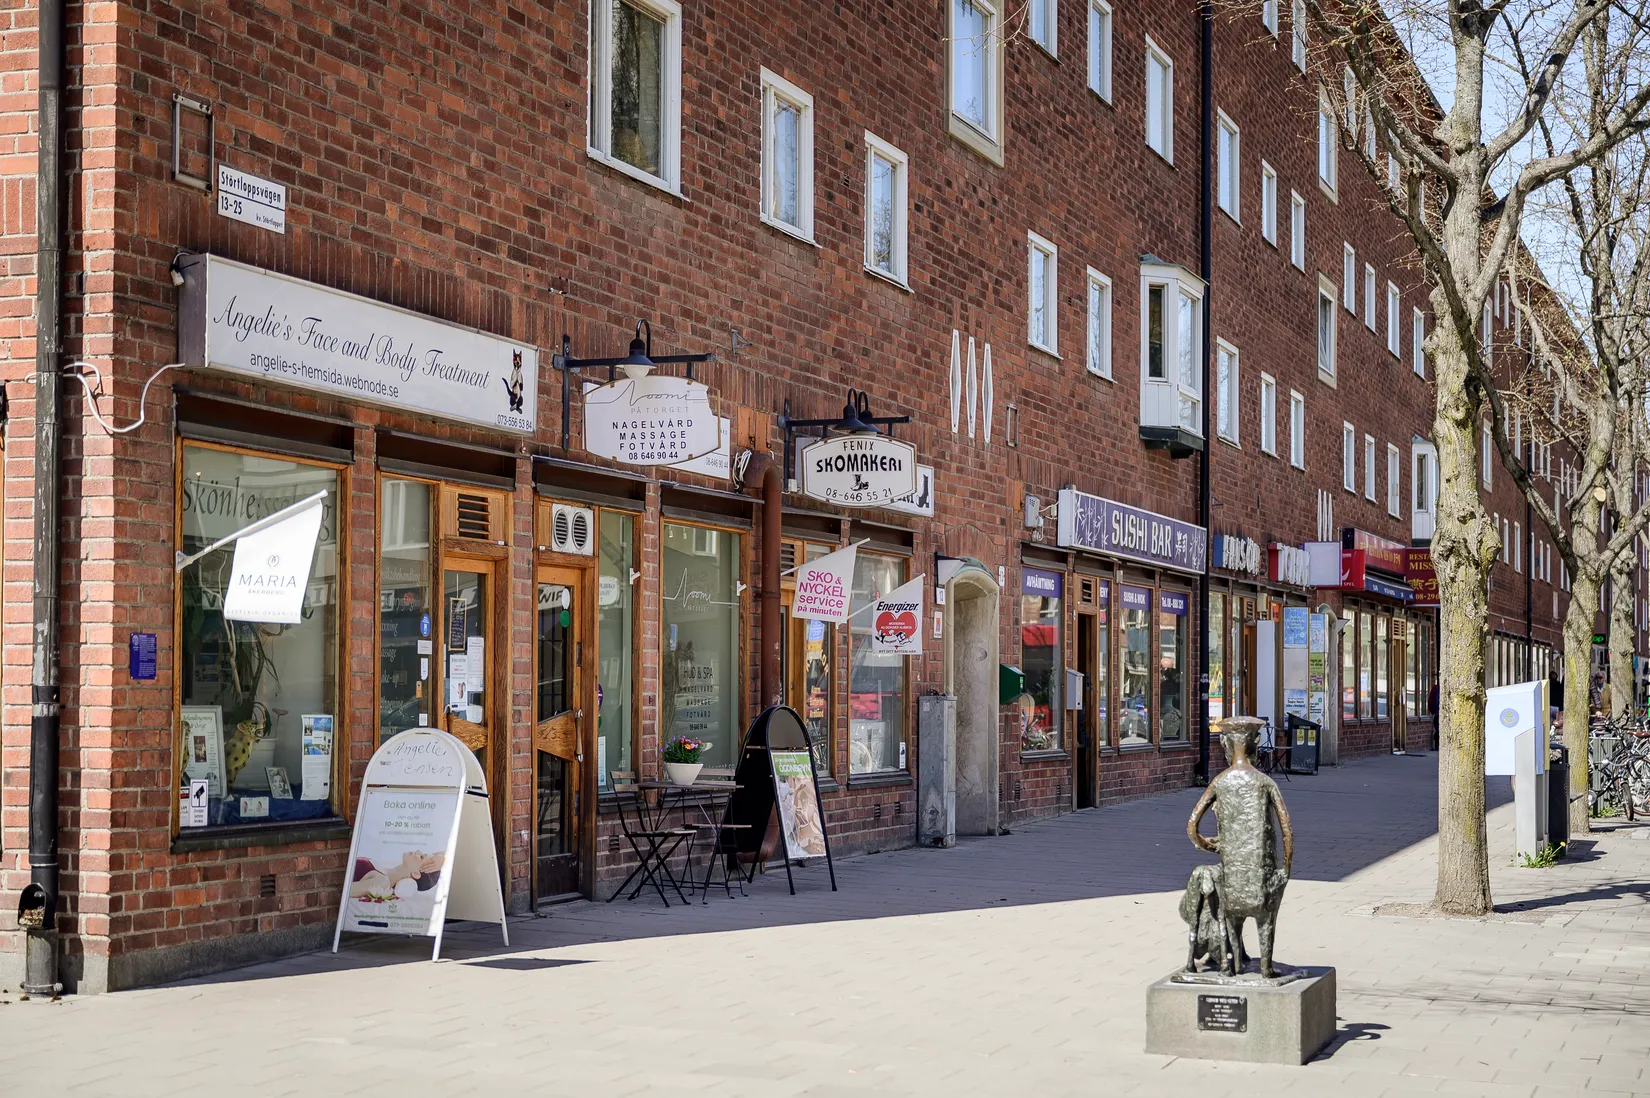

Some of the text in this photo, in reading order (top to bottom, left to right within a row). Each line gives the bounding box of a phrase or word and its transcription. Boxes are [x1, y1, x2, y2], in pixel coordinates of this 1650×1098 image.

[221, 171, 281, 204] Störtloppsvägen
[221, 195, 242, 215] 13-25
[213, 295, 490, 389] Angelie's Face and Body Treatment
[250, 353, 399, 398] angelie-s-hemsida.webnode.se
[646, 406, 689, 414] TORGET
[518, 418, 525, 428] 53
[525, 420, 532, 430] 84
[612, 418, 693, 430] NAGELVÅRD
[620, 431, 686, 440] MASSAGE
[619, 440, 687, 451] FOTVÅRD
[843, 440, 875, 451] FENIX
[628, 452, 638, 460] 08
[641, 452, 655, 460] 646
[669, 451, 678, 459] 44
[816, 453, 902, 472] SKOMAKERI
[825, 487, 893, 502] 08-646 55 21
[1111, 509, 1173, 558] SUSHI BAR
[1409, 561, 1434, 570] MISS
[238, 574, 297, 588] MARIA
[807, 570, 842, 585] SKO &
[799, 581, 846, 598] NYCKEL
[1100, 586, 1109, 598] ENY
[799, 594, 843, 608] service
[876, 601, 919, 613] Energizer
[797, 604, 842, 616] på minuten
[384, 800, 436, 810] Boka online
[410, 821, 430, 829] rabatt
